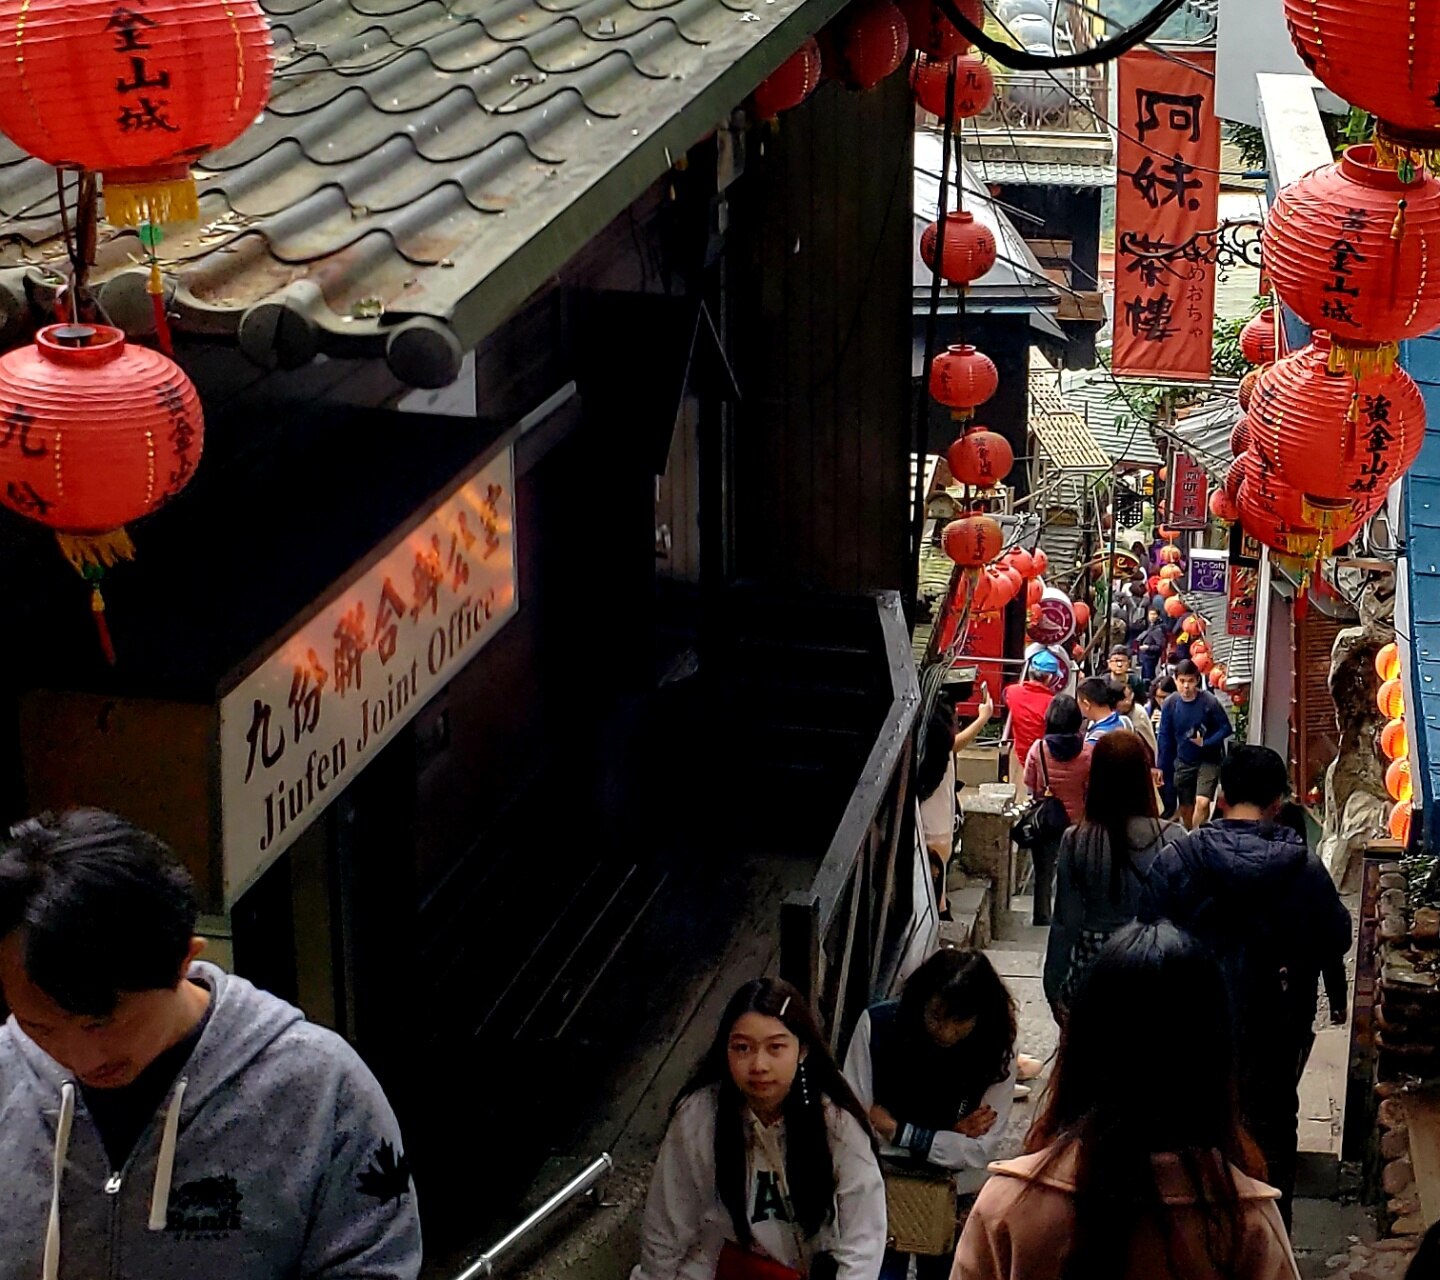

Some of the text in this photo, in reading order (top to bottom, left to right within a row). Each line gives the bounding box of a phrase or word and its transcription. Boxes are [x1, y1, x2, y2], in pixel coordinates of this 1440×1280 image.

[259, 587, 496, 851] Jiufen Joint Office
